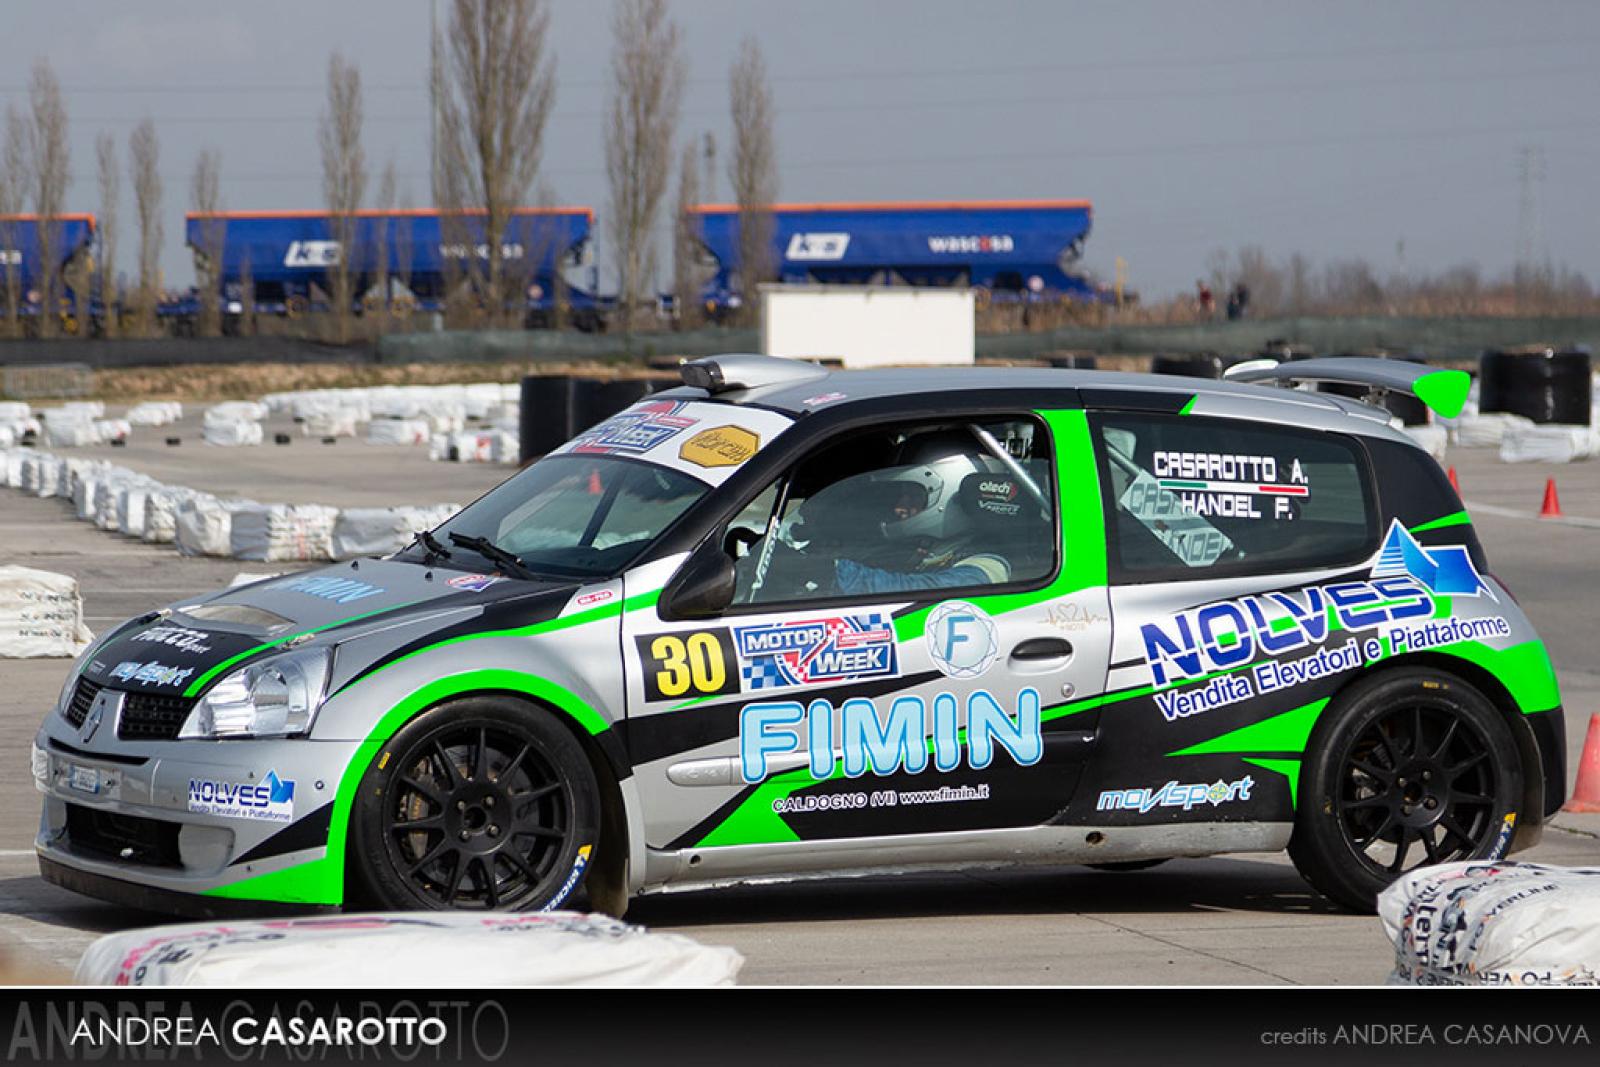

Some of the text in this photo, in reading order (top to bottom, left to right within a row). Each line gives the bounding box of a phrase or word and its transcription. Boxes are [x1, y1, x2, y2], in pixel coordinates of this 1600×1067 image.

[1153, 451, 1309, 484] CASAROTTO A.
[1182, 492, 1293, 520] HANDEL F.
[746, 629, 824, 650] MOTOR
[1140, 578, 1434, 687] NOLVES
[651, 633, 728, 697] 30
[817, 647, 884, 674] WEEK
[1155, 615, 1510, 721] Vendita Elevatori e Piattaforme
[740, 687, 1043, 784] FIMIN
[188, 780, 270, 807] NOLVES
[772, 783, 990, 814] CALDOGNO (VI) www.fimin.it
[1096, 775, 1255, 814] movisport
